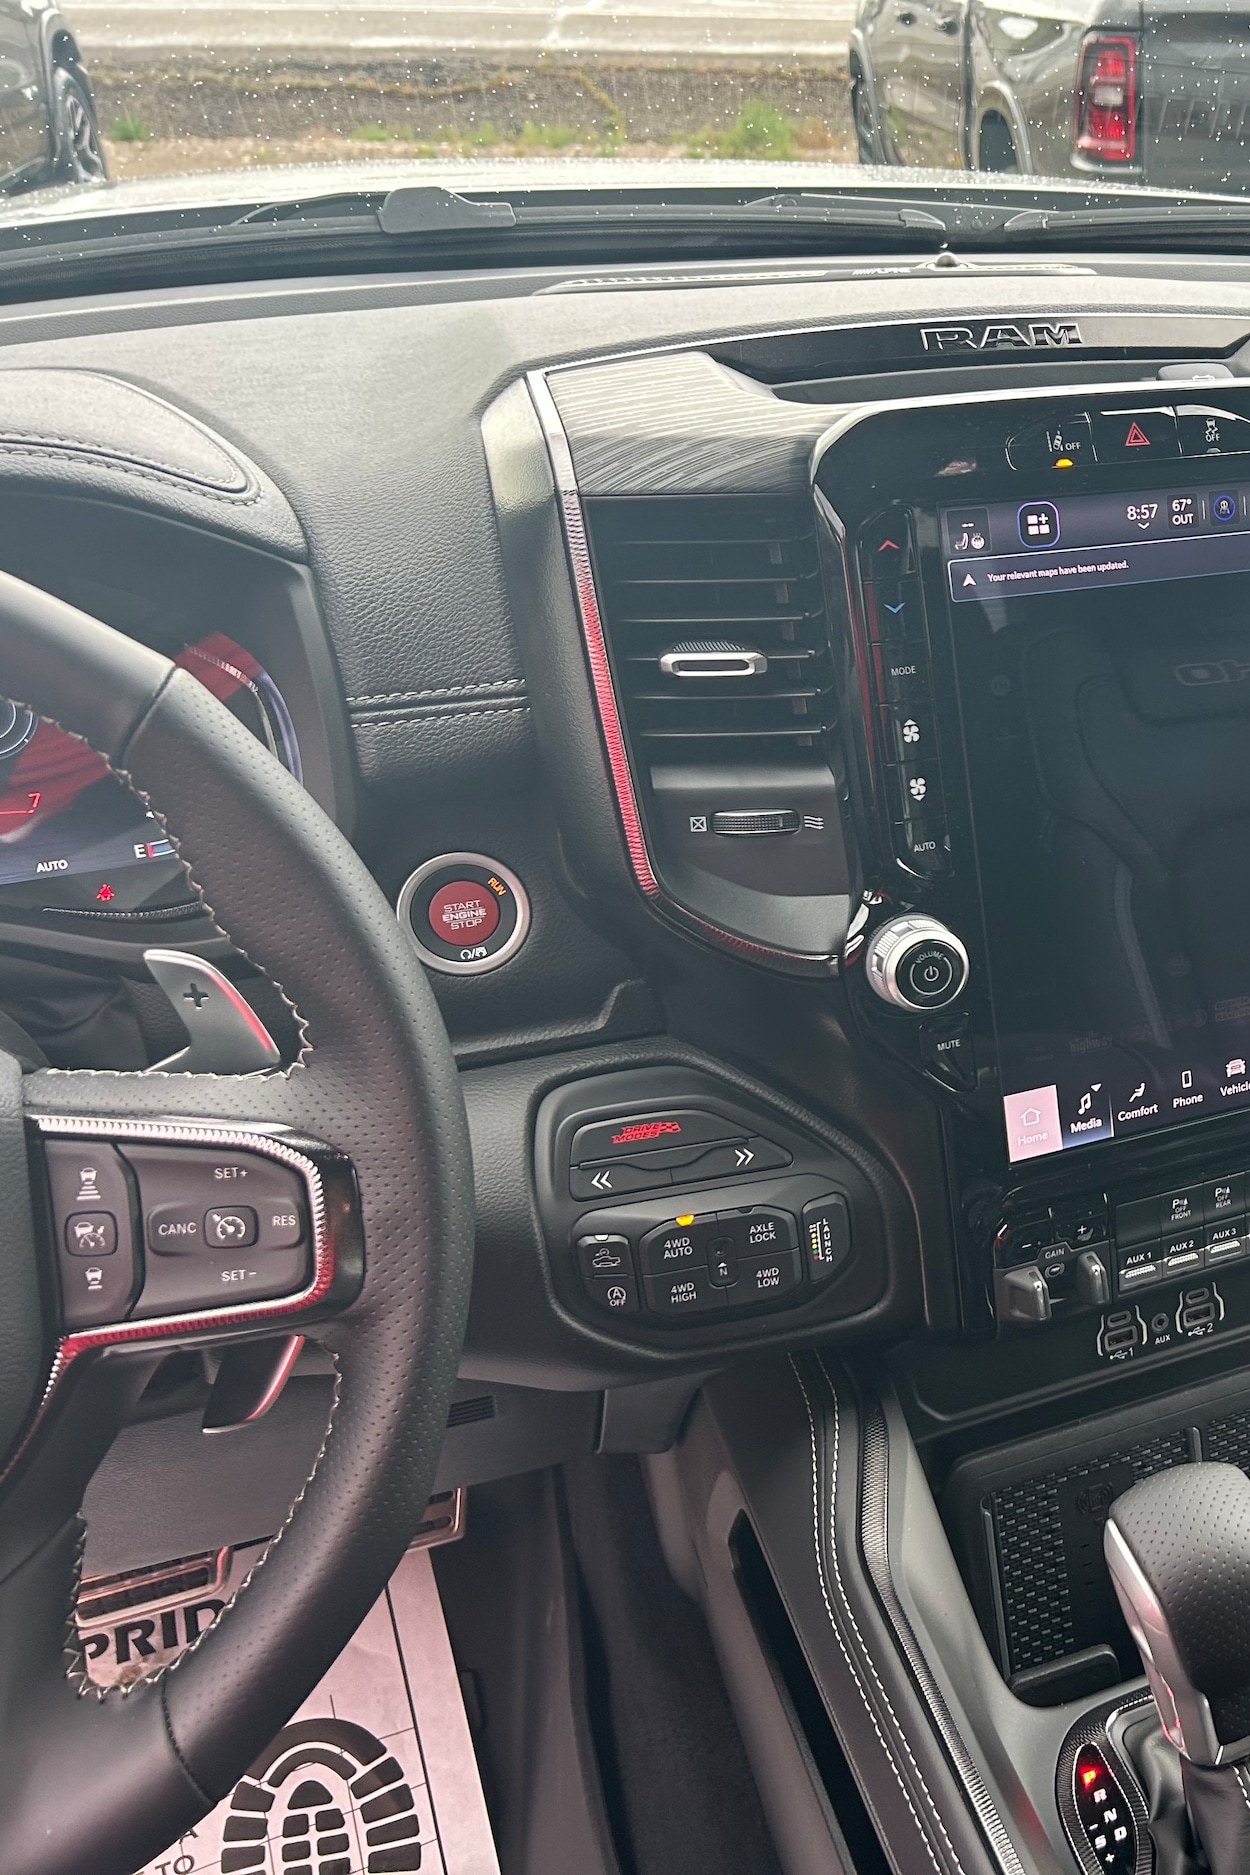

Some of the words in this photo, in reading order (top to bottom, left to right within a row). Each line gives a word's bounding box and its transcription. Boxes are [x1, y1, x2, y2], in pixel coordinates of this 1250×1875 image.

[920, 323, 1083, 350] RAM
[1205, 433, 1220, 442] OFF
[1065, 442, 1081, 451] OFF
[1172, 498, 1192, 512] 67°
[1127, 503, 1158, 521] 8:57
[1172, 513, 1193, 525] OUT
[987, 573, 1007, 582] Your
[1007, 570, 1038, 581] relevant
[1038, 569, 1058, 578] maps
[1059, 566, 1077, 575] have
[1078, 564, 1097, 573] been
[1097, 560, 1129, 573] updated.
[891, 666, 917, 676] MODE
[133, 844, 145, 859] E
[914, 841, 936, 853] AUTO
[36, 859, 68, 873] AUTO
[487, 877, 507, 896] RUN
[444, 900, 480, 912] START
[442, 908, 487, 922] ENGINE
[451, 918, 482, 930] STOP
[915, 950, 945, 964] VOLUME
[937, 1039, 961, 1051] MUTE
[1173, 1092, 1204, 1109] Phone
[1118, 1103, 1159, 1121] Comfort
[623, 1123, 659, 1134] DRIVE
[1070, 1116, 1102, 1133] Media
[614, 1131, 657, 1142] MODES
[1017, 1130, 1049, 1146] Home
[1215, 1199, 1231, 1208] REAR
[272, 1215, 296, 1226] RES
[1171, 1210, 1191, 1221] FRONT
[158, 1222, 197, 1235] CANC
[749, 1221, 775, 1235] AXLE
[1212, 1230, 1229, 1240] AUX
[1230, 1228, 1236, 1236] 3
[664, 1237, 690, 1249] 4WD
[750, 1231, 777, 1244] LOCK
[821, 1218, 833, 1262] LAUNCH
[663, 1246, 693, 1260] AUTO
[1170, 1242, 1187, 1253] AUX
[1188, 1240, 1194, 1248] 2
[1045, 1248, 1065, 1260] GAIN
[1126, 1253, 1145, 1265] AUX
[719, 1267, 728, 1276] N
[756, 1267, 780, 1279] 4WD
[671, 1282, 695, 1294] 4WD
[757, 1276, 780, 1289] LOW
[609, 1298, 625, 1306] OFF
[671, 1291, 697, 1304] HIGH
[1206, 1322, 1214, 1333] 2
[1155, 1334, 1171, 1345] AUX
[1129, 1347, 1134, 1357] 1
[1083, 1770, 1097, 1785] P
[1093, 1788, 1107, 1803] R
[1103, 1808, 1118, 1824] N
[1114, 1825, 1128, 1842] D
[1094, 1834, 1107, 1850] S
